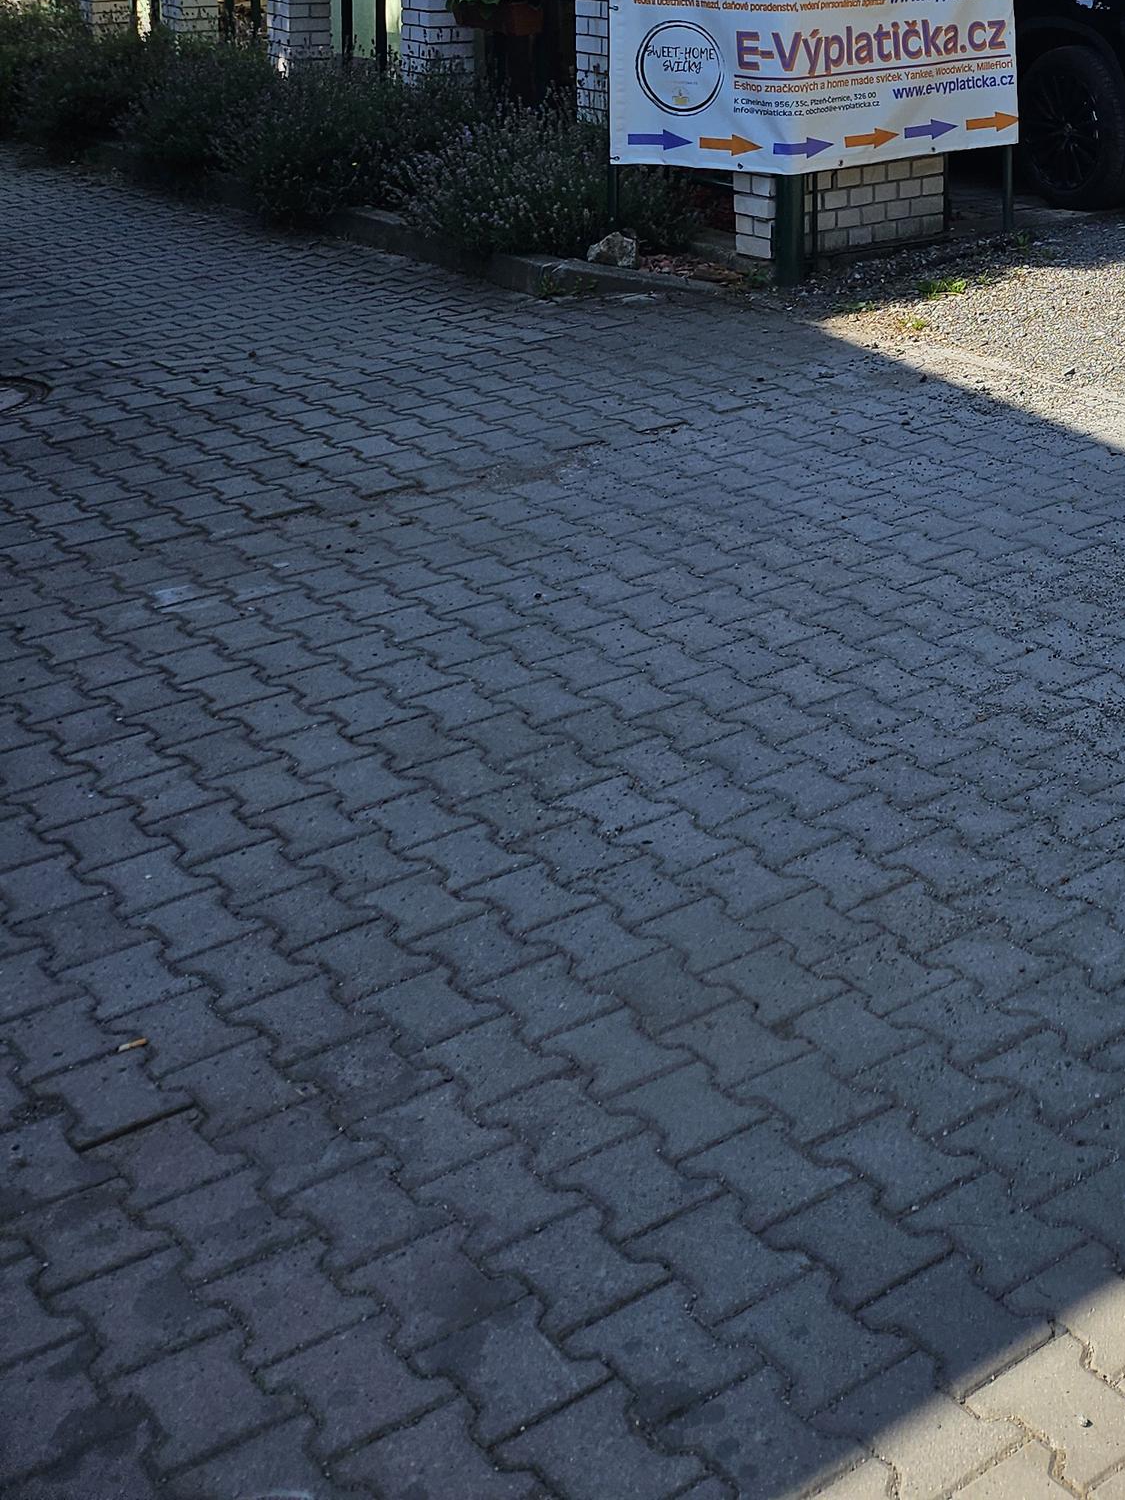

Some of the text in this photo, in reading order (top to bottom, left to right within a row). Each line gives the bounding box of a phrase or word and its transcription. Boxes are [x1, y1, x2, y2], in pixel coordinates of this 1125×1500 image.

[722, 0, 749, 11] daňové
[750, 0, 799, 13] poradenství,
[736, 19, 1007, 77] E-Výplatička.cz
[733, 81, 762, 93] E-shop
[764, 81, 819, 94] značkových
[826, 78, 850, 89] home
[850, 76, 874, 86] made
[893, 74, 1015, 100] www.e-vyplaticka.cz
[853, 92, 867, 100] 326
